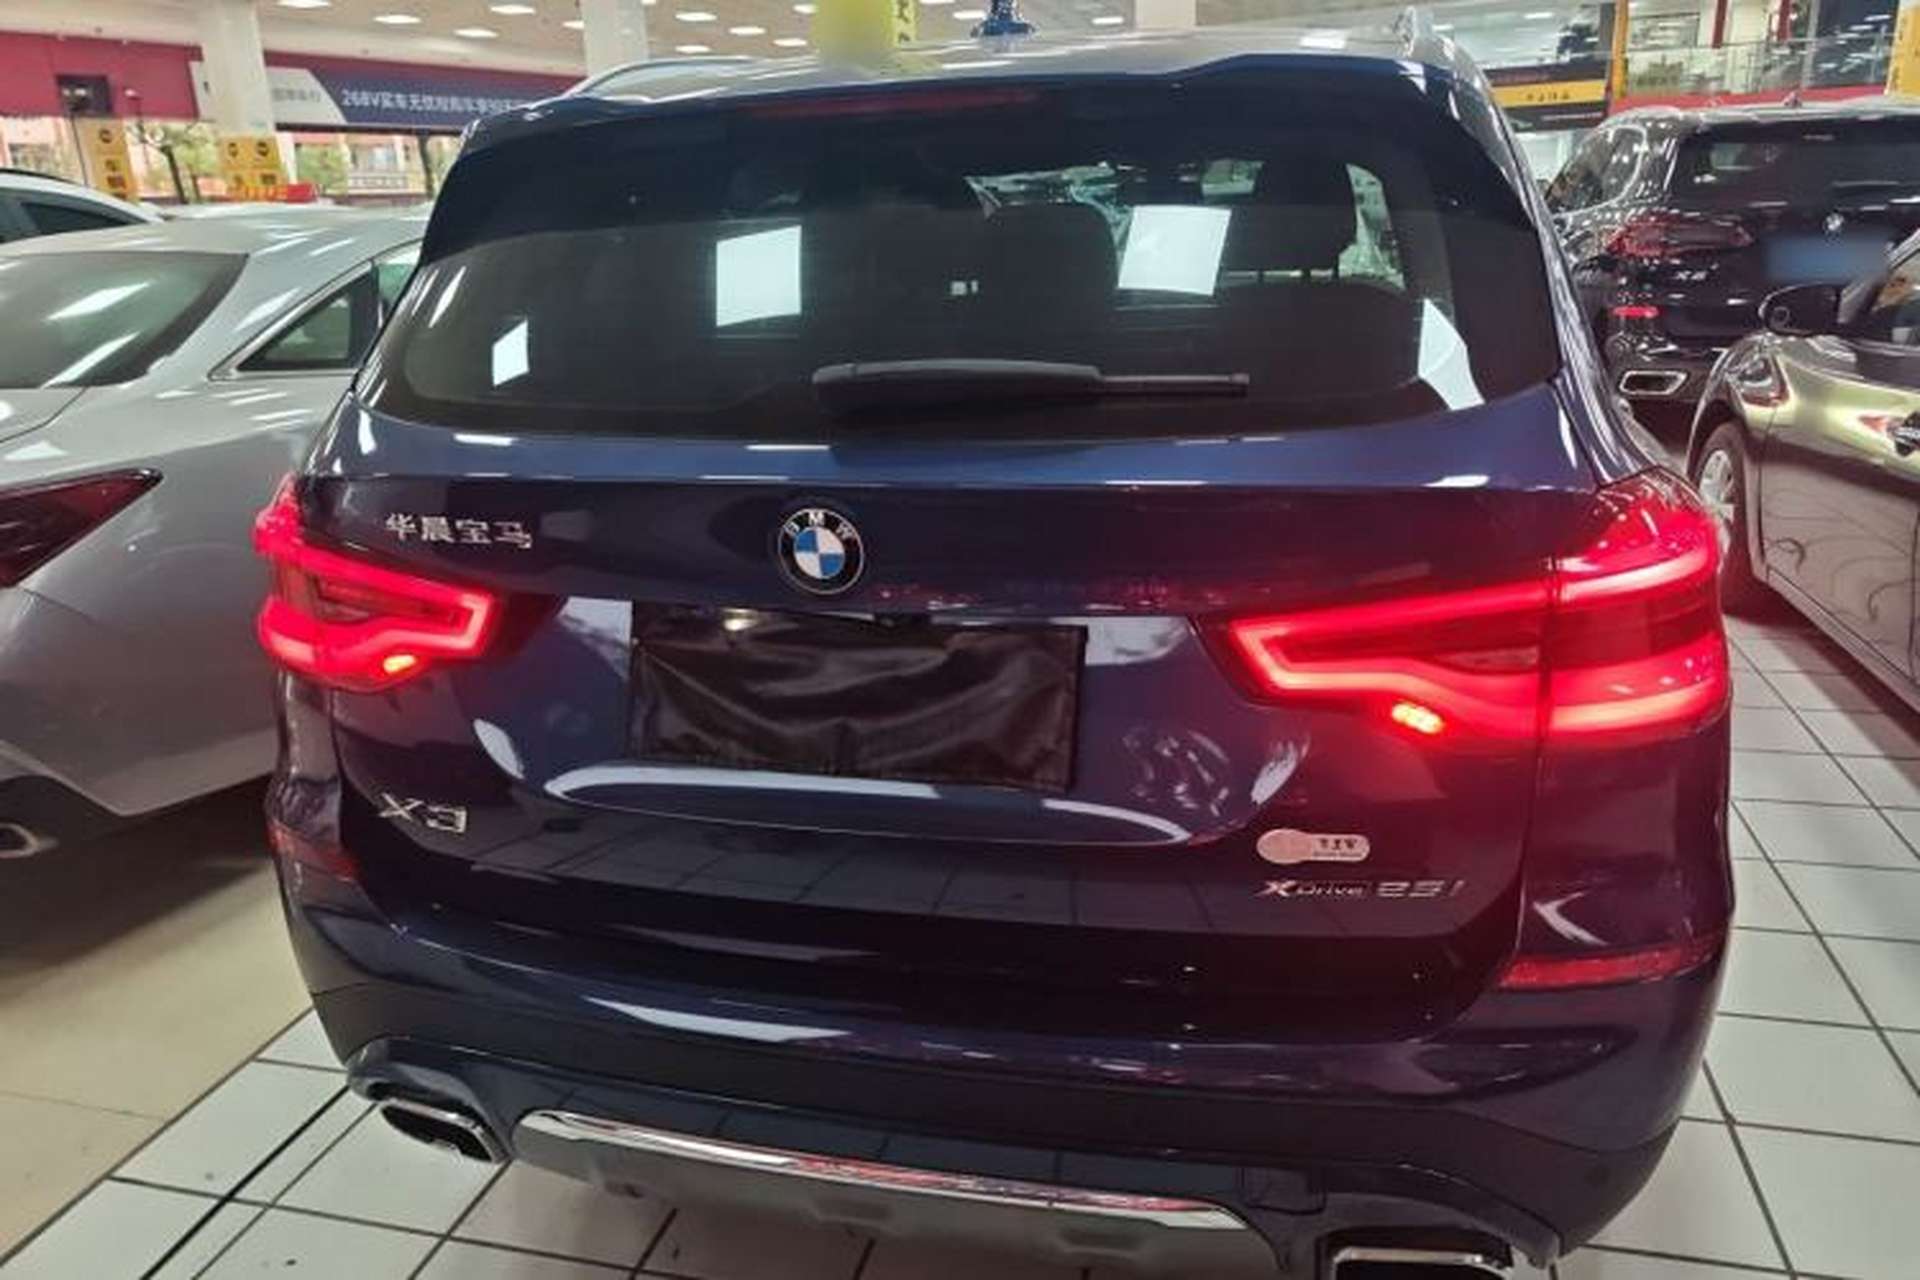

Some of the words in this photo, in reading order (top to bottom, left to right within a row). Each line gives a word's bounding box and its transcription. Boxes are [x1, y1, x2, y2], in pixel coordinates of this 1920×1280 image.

[385, 513, 532, 548] 华晨宝马
[784, 511, 856, 540] BMW
[379, 793, 467, 832] X3
